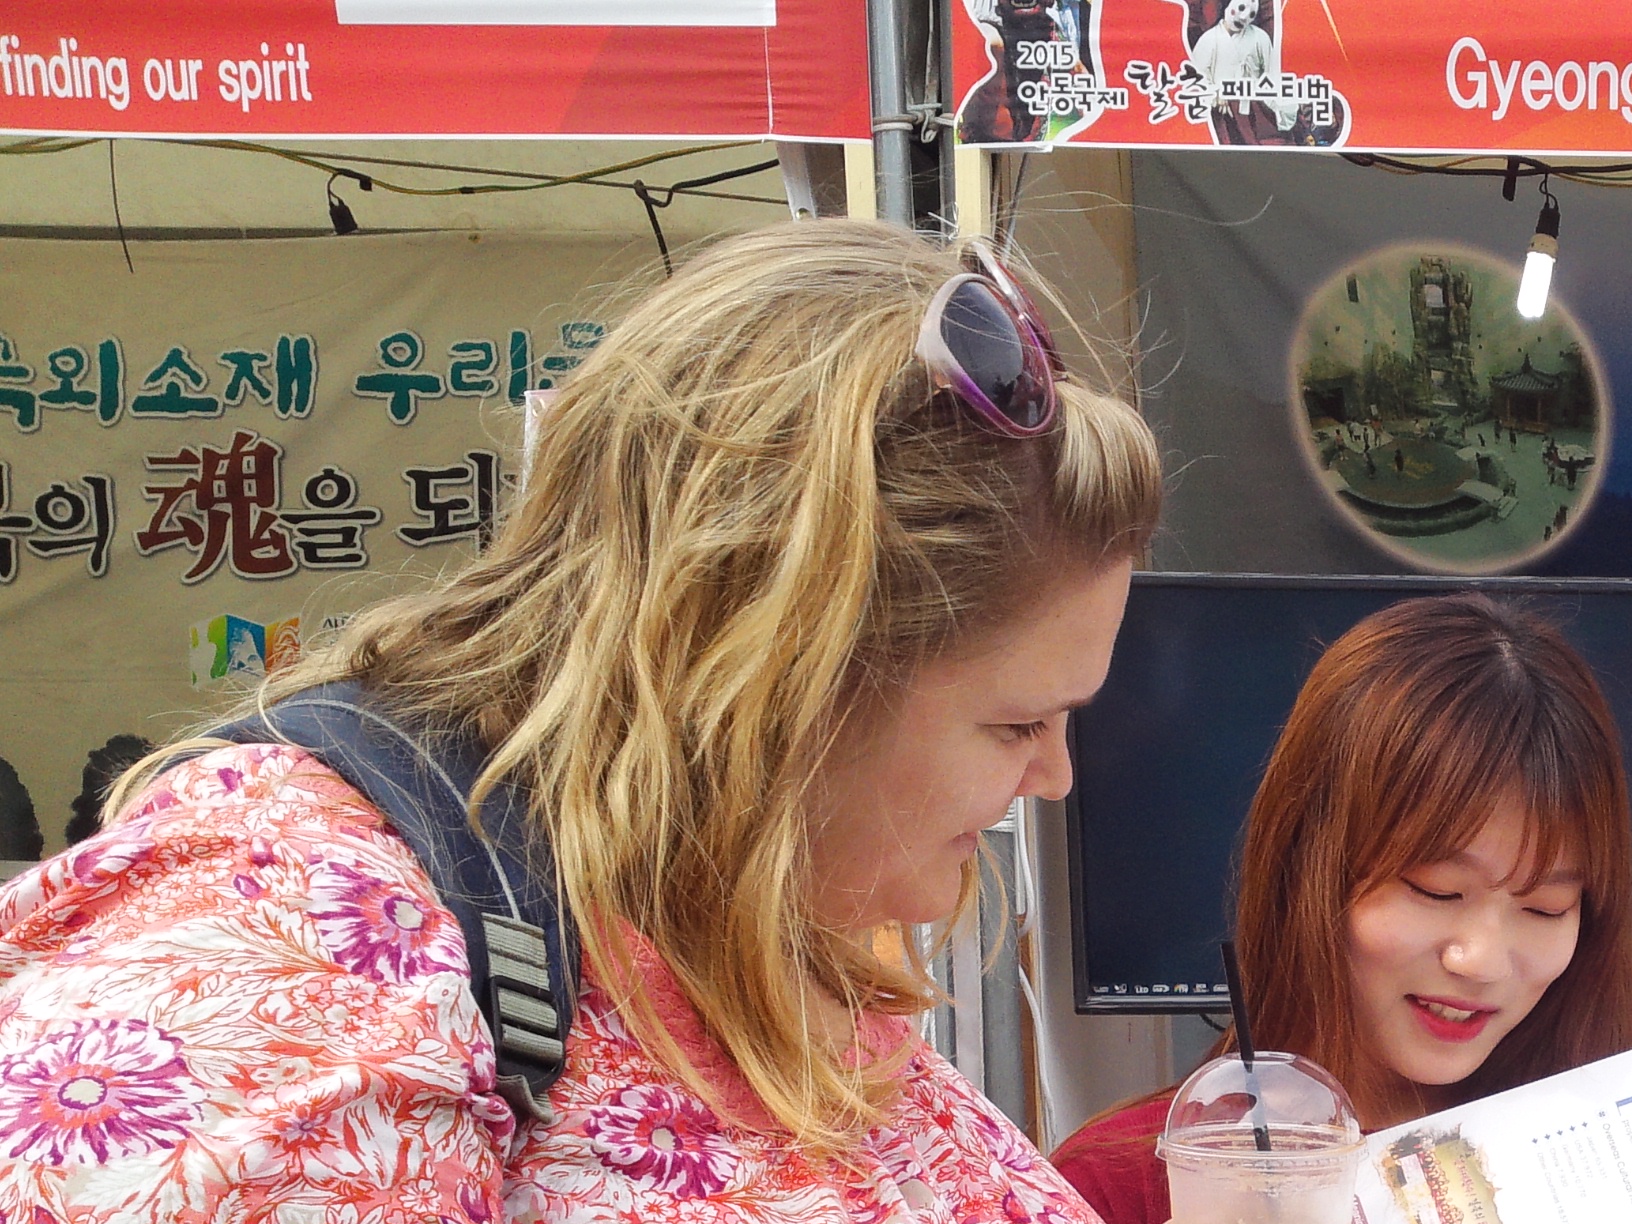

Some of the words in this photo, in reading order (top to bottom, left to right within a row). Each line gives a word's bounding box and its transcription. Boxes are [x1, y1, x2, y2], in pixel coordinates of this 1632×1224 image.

[0, 36, 131, 110] finding
[144, 55, 202, 102] our
[219, 42, 312, 113] spirit
[1018, 44, 1074, 67] 2015
[1020, 75, 1125, 113] 안동국제
[1127, 63, 1212, 122] 탈춤
[1221, 78, 1331, 124] 페스티벌
